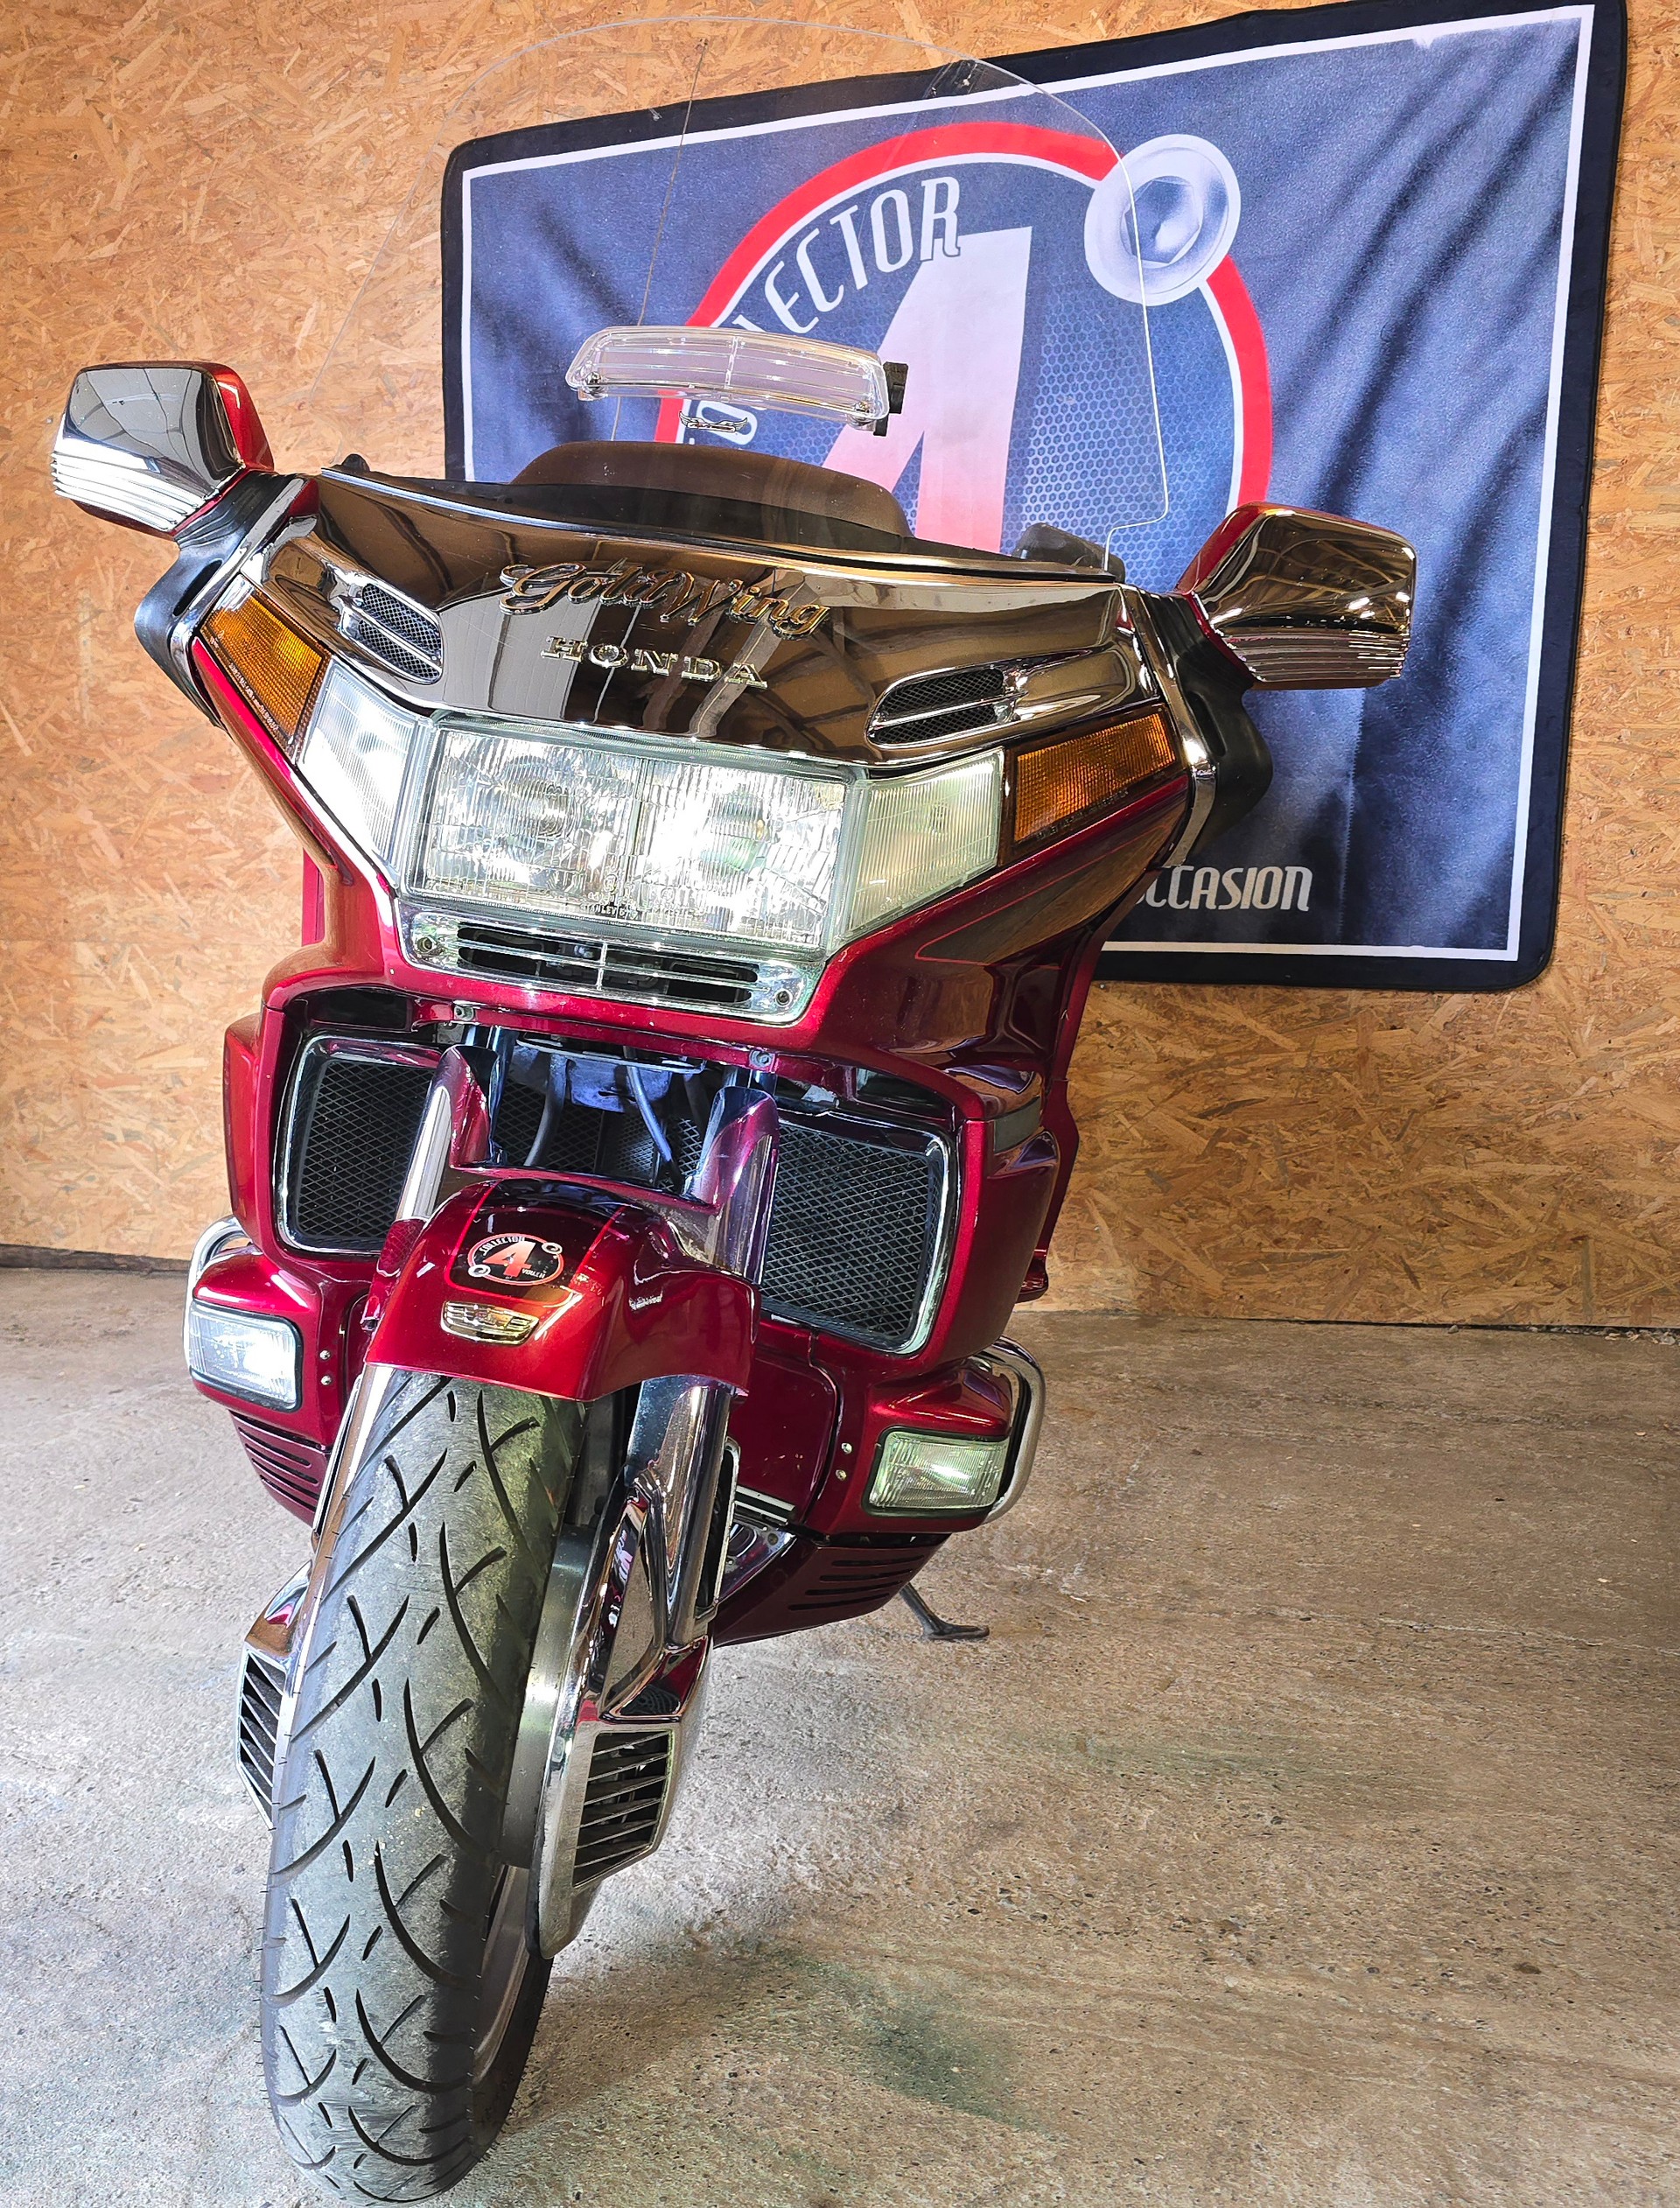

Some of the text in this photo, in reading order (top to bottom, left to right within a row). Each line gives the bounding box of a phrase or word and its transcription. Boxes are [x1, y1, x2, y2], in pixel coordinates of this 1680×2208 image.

[540, 634, 768, 690] HONDA
[1135, 865, 1312, 912] CCASION
[482, 1240, 536, 1278] 4
